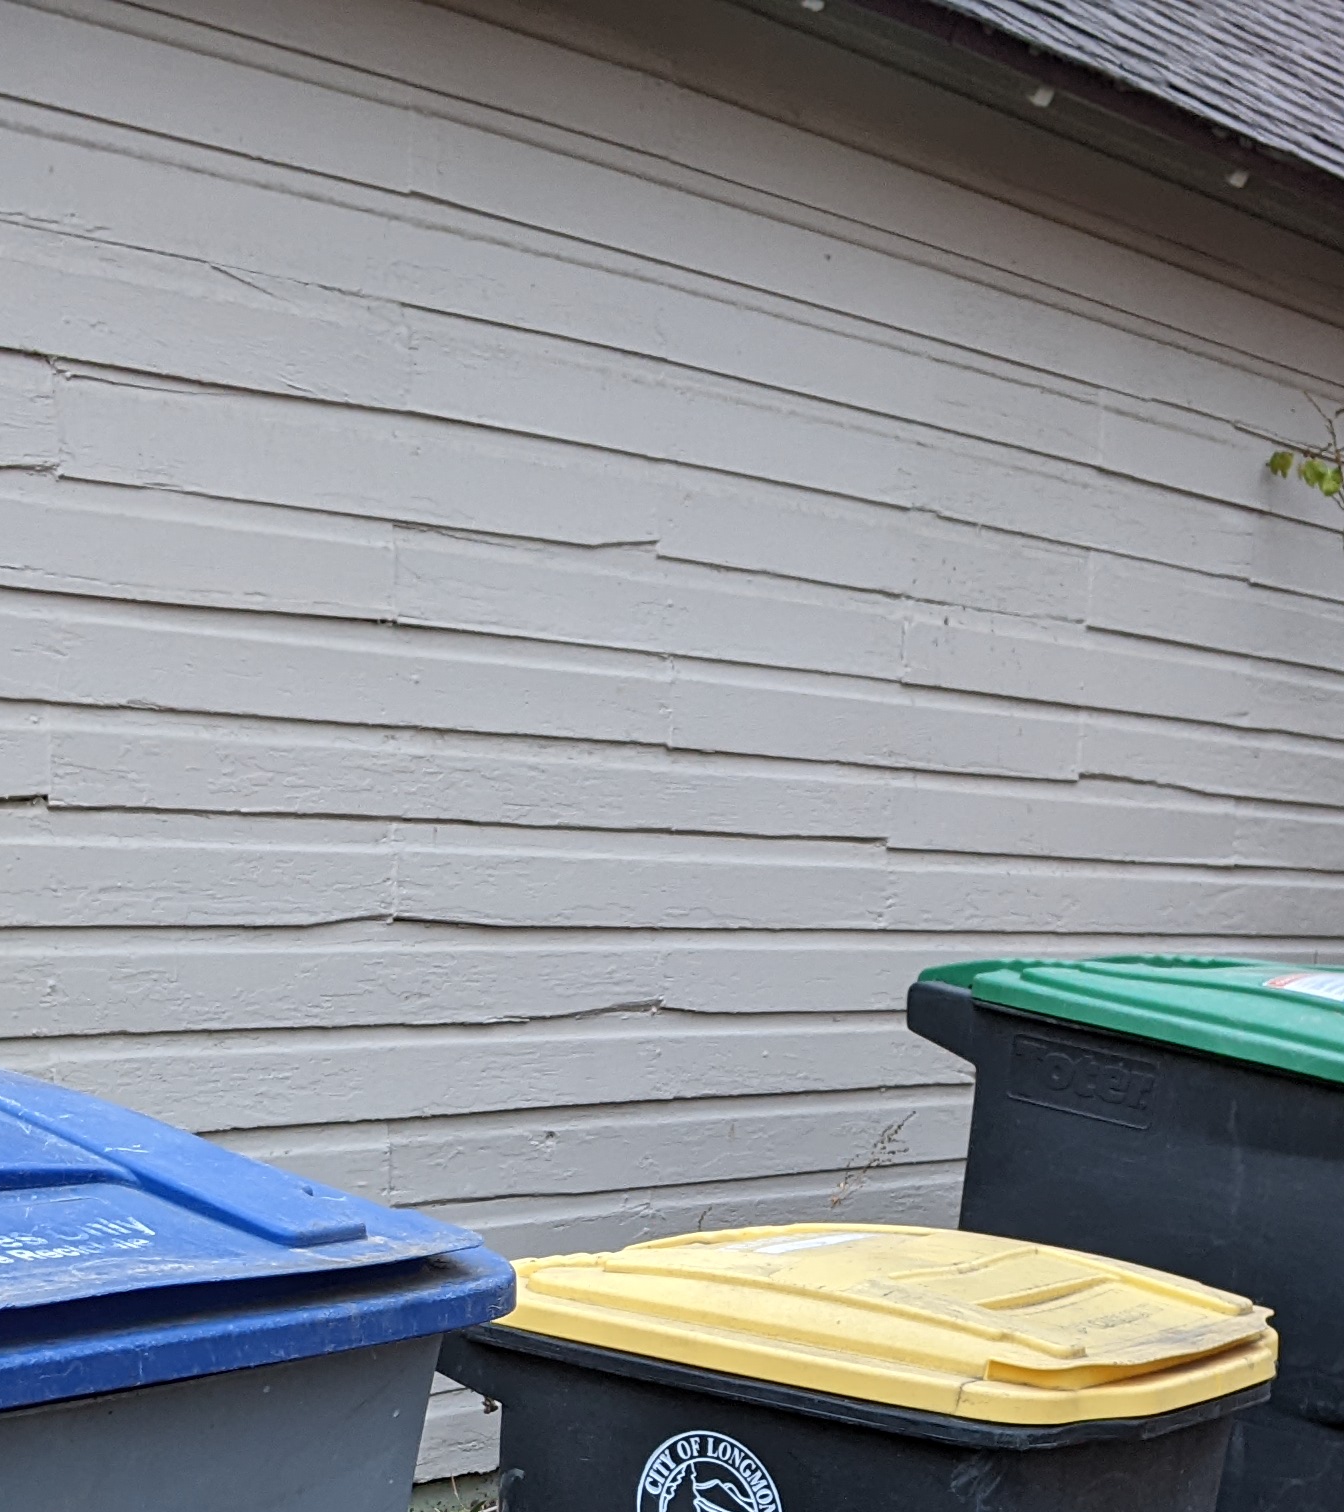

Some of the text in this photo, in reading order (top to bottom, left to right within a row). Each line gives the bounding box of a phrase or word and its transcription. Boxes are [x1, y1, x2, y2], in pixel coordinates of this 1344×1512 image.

[1013, 1039, 1156, 1111] Toter
[7, 1237, 150, 1262] Reciclble
[46, 1216, 156, 1241] Only
[644, 1449, 678, 1496] CITY
[676, 1436, 702, 1459] OF
